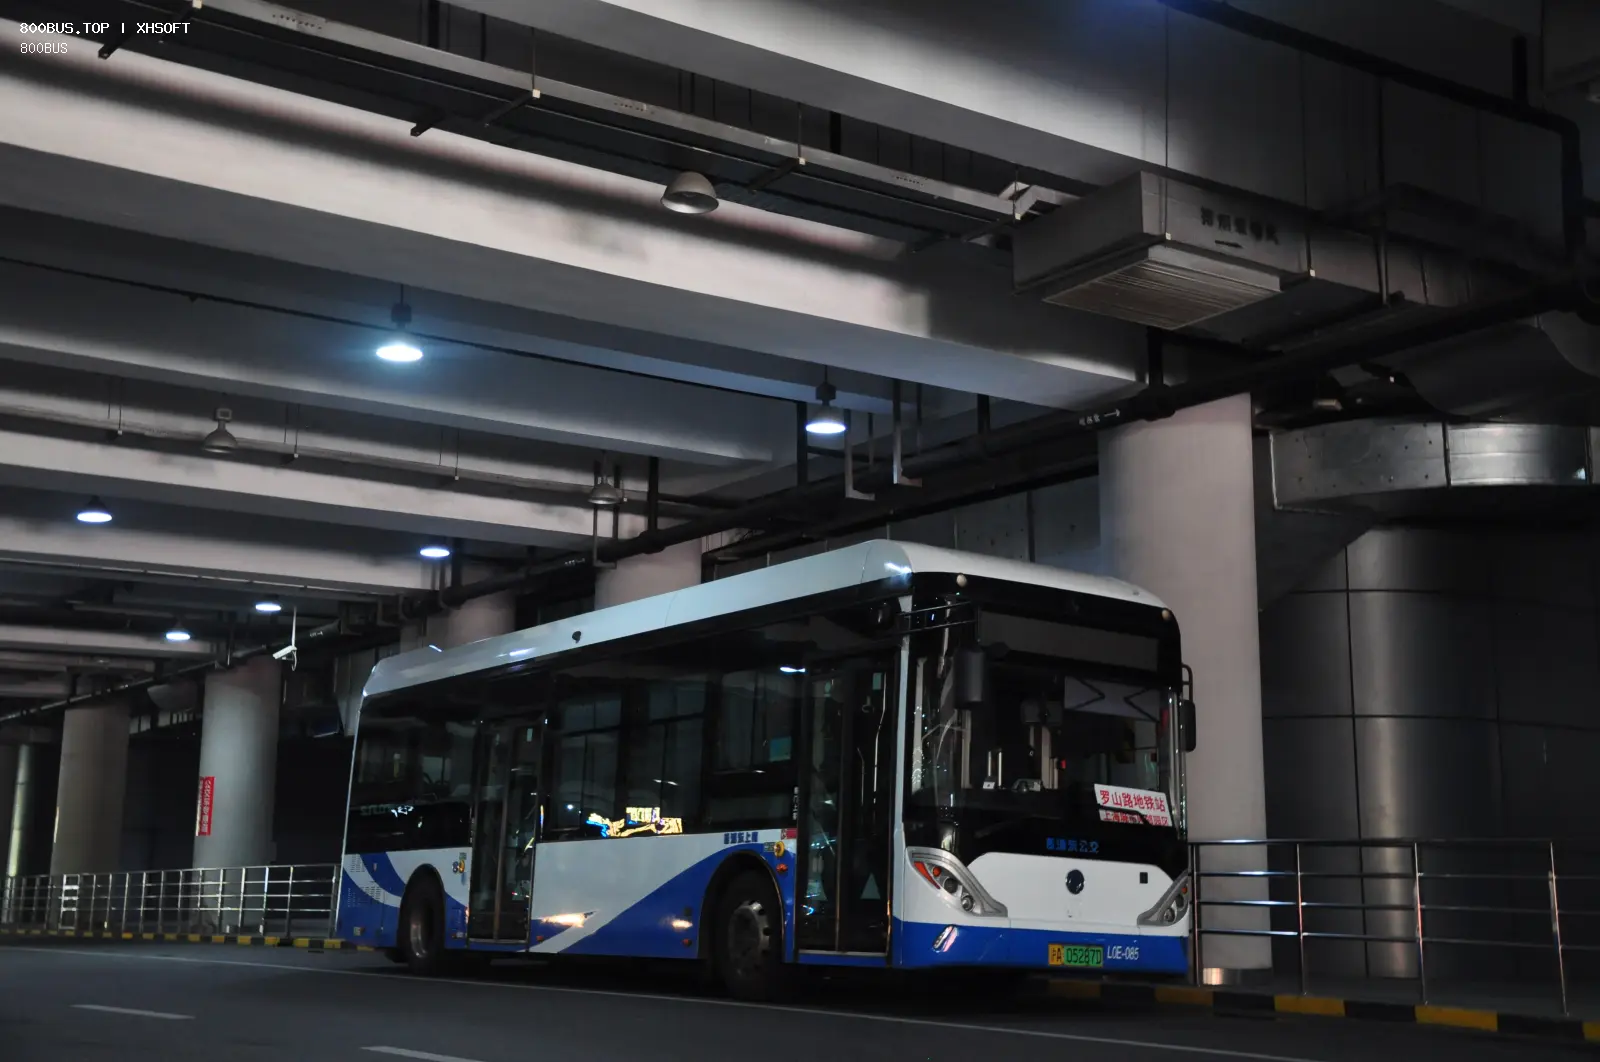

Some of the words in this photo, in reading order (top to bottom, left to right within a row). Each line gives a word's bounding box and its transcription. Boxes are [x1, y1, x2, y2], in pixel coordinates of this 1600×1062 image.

[1099, 789, 1166, 813] 罗山路地铁站
